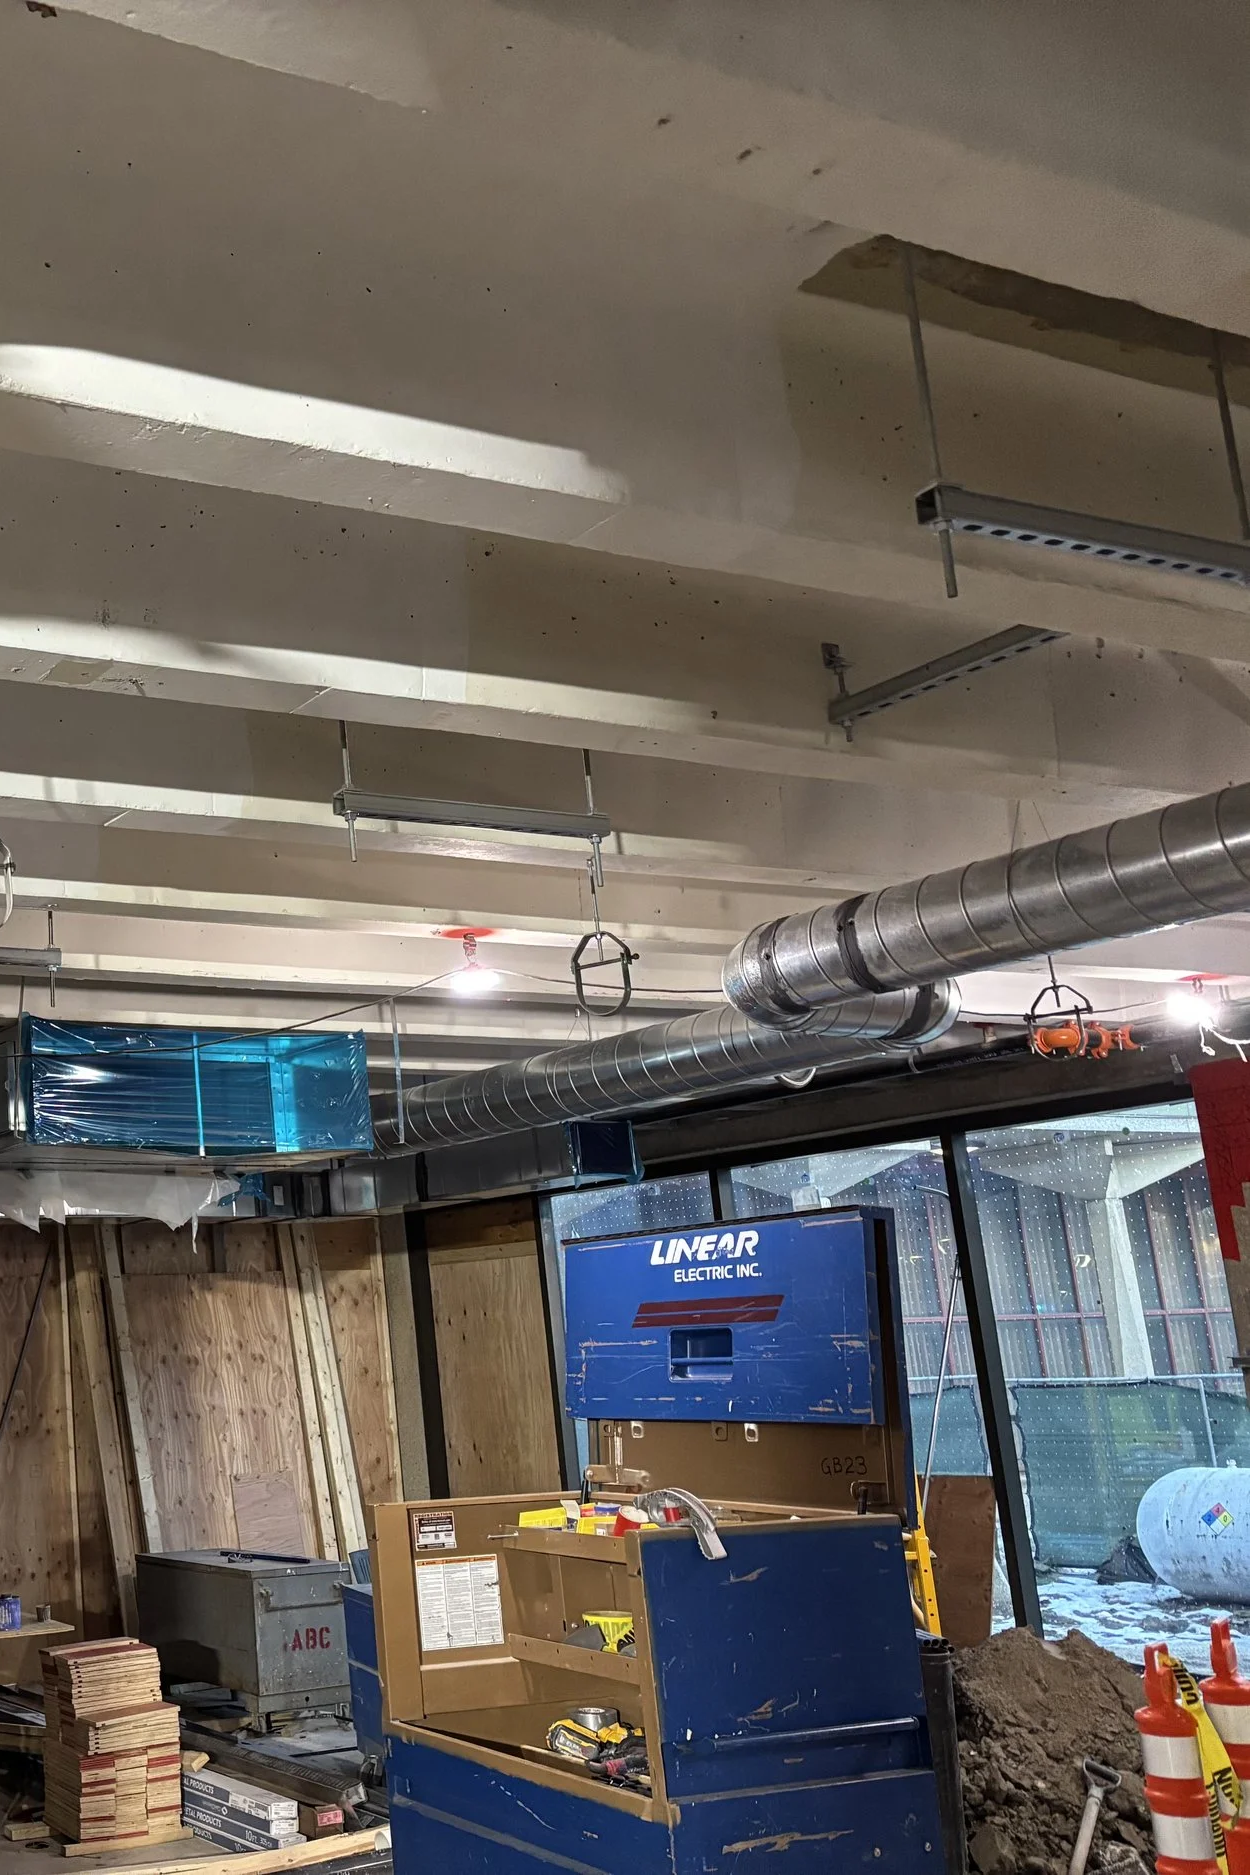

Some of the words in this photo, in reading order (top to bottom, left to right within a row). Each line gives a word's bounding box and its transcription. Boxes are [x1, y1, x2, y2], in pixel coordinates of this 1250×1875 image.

[650, 1231, 759, 1265] LINEAR
[674, 1265, 733, 1283] ELECTRIC
[736, 1262, 762, 1278] INC.
[292, 1627, 330, 1651] ABC
[190, 1780, 214, 1794] PRODUCTS
[196, 1811, 222, 1828] PRODUCTS
